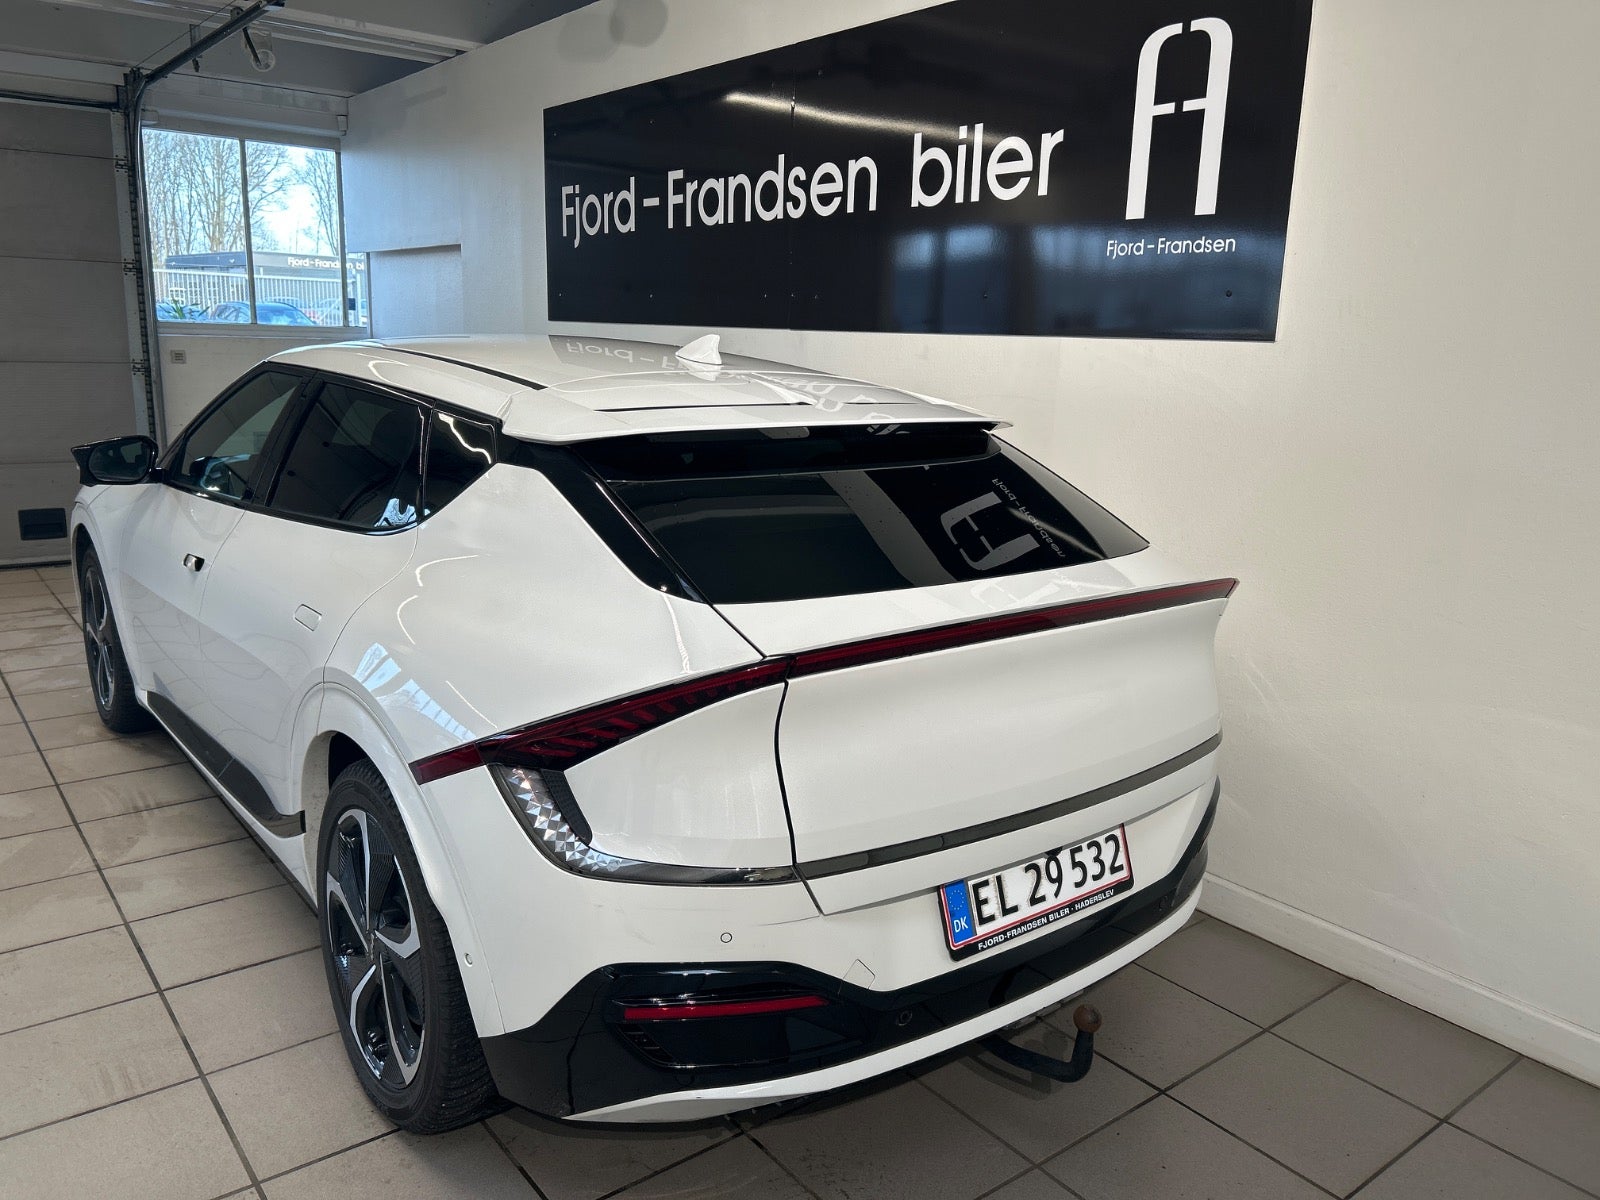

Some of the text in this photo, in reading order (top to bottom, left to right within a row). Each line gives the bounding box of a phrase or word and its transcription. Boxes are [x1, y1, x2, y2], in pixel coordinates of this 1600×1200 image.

[910, 122, 1065, 208] biler
[971, 833, 1125, 927] EL 29 532
[953, 915, 969, 934] DK
[977, 888, 1115, 951] FJORD-FRANDSEN BILER HADERSLEV
